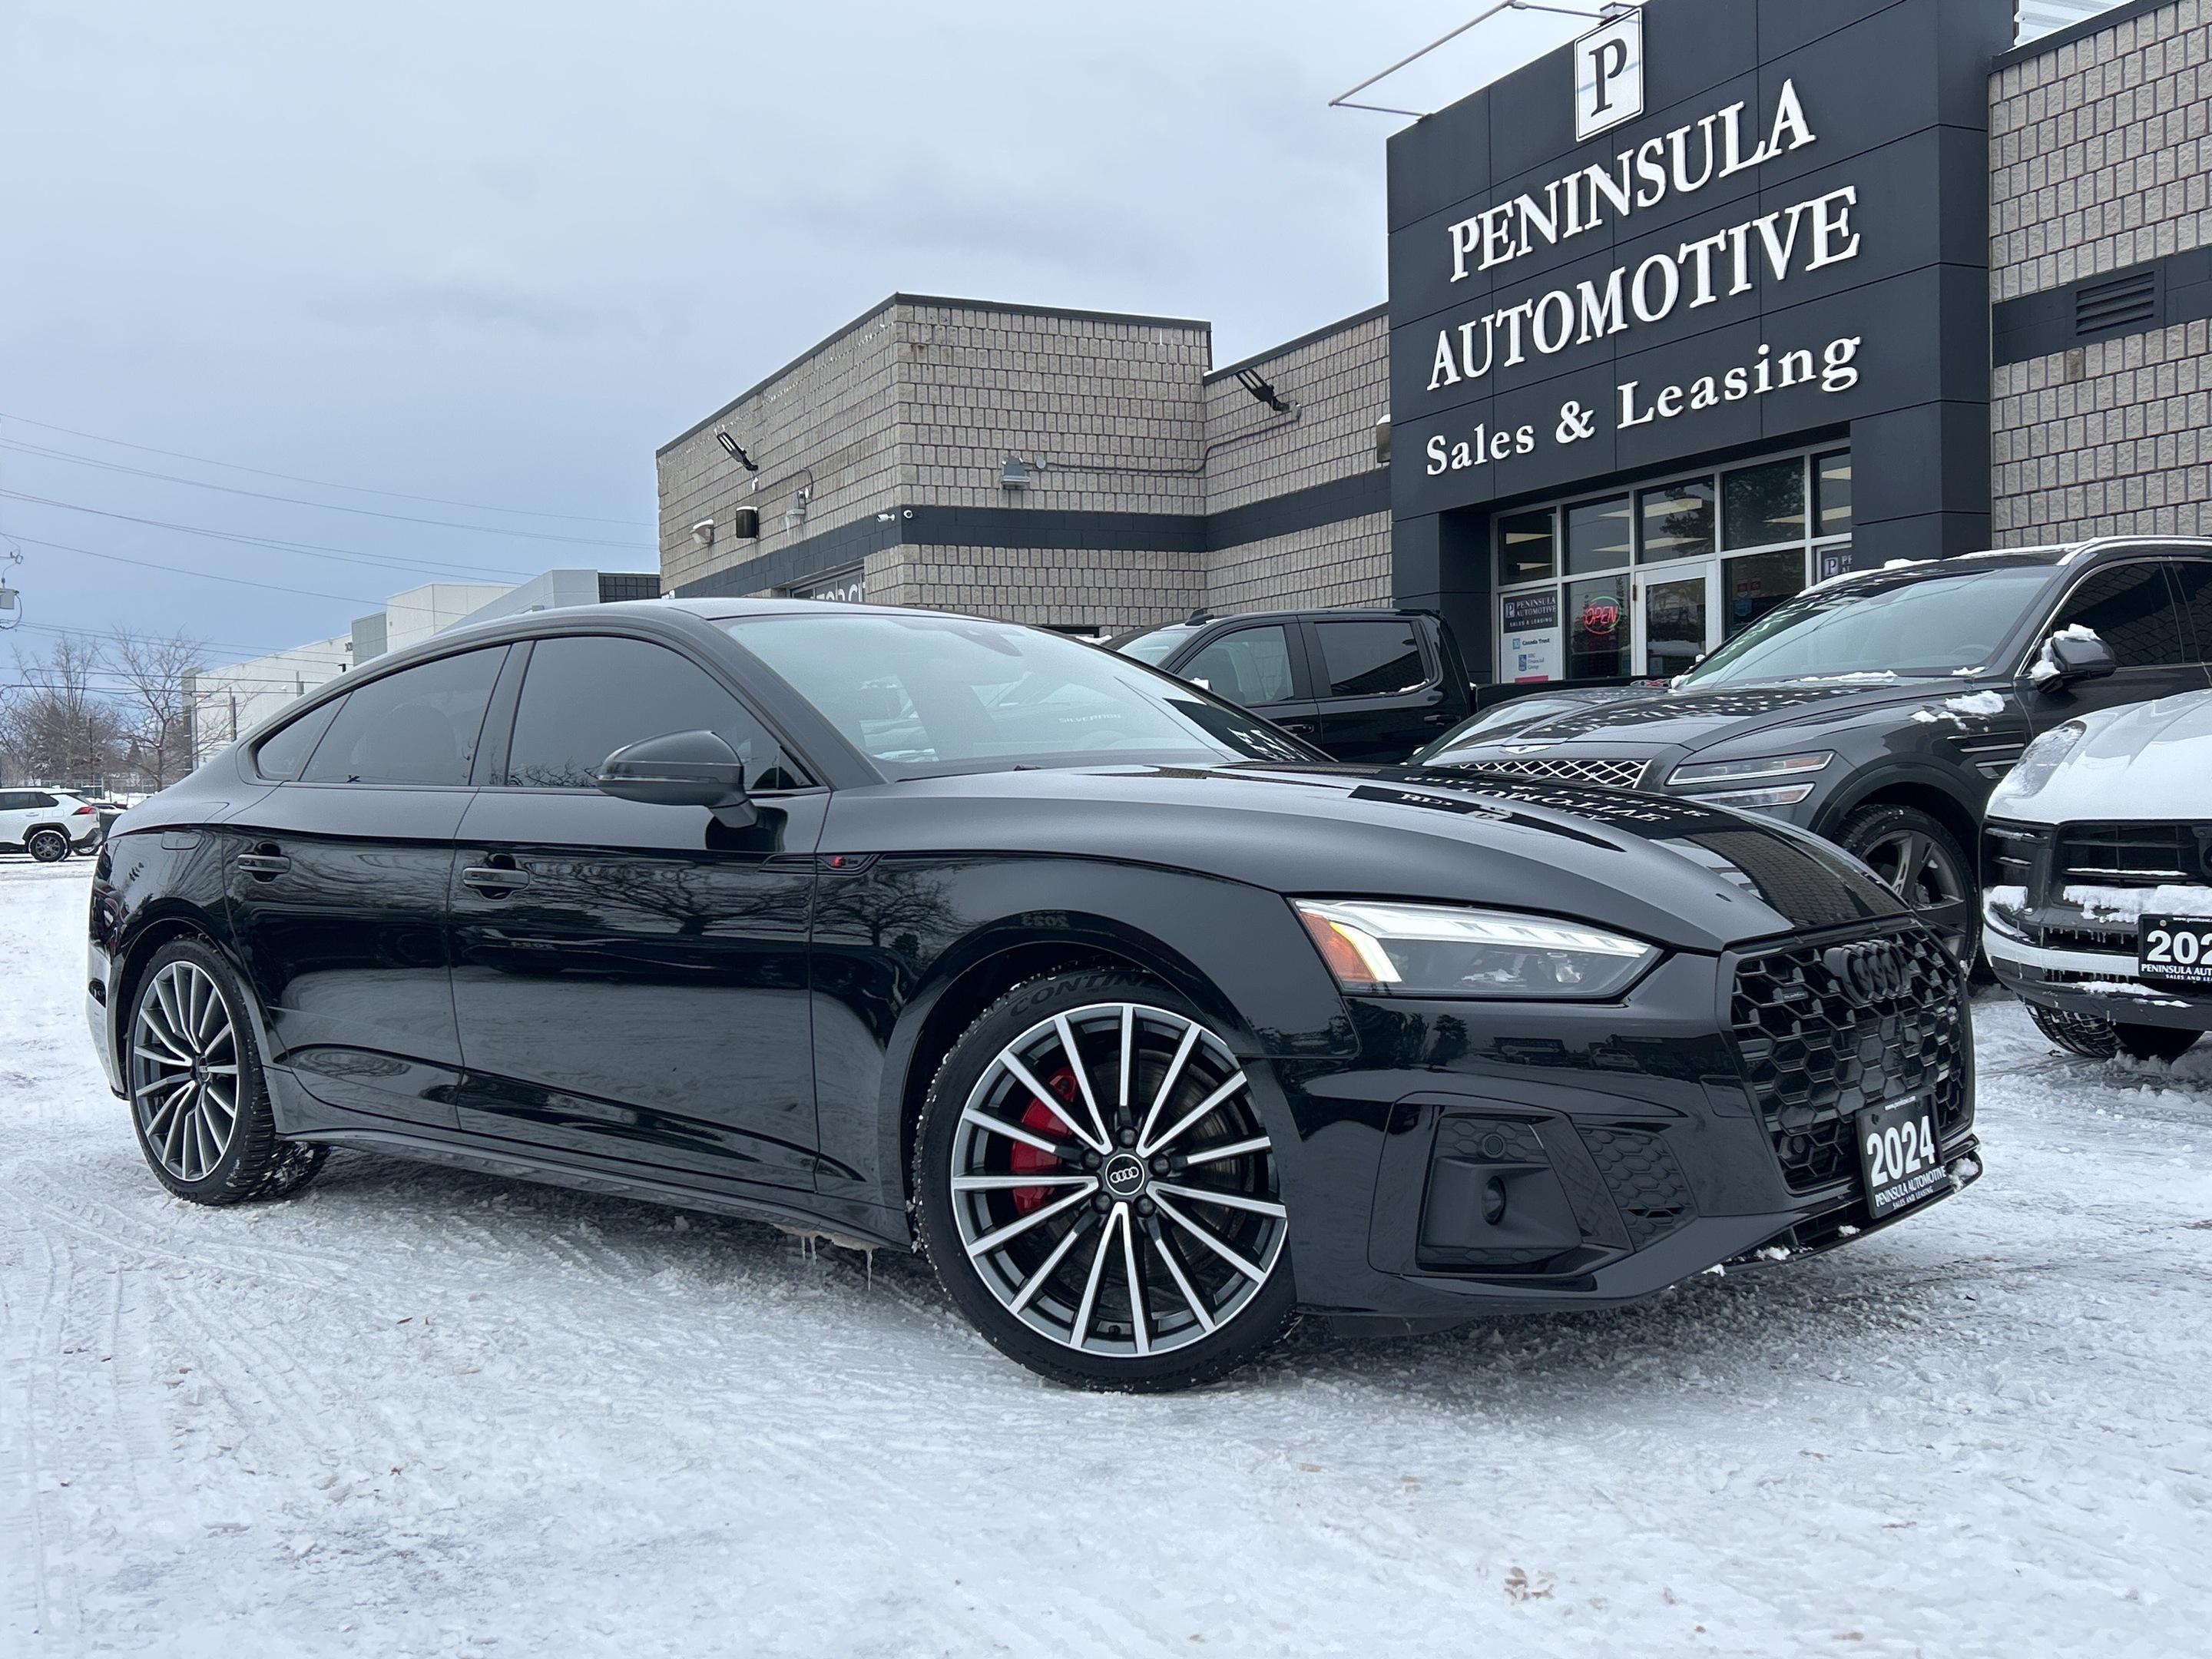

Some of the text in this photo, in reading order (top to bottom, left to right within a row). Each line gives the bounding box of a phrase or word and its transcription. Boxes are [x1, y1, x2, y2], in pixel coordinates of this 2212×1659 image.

[1588, 38, 1628, 118] P
[1449, 78, 1816, 283] PENINSULA
[1427, 186, 1860, 390] AUTOMOTIVE
[1426, 336, 1862, 475] Sales & Leasing
[1516, 597, 1556, 609] PENINSULA
[1516, 605, 1557, 617] AUTOMOTIVE
[1584, 605, 1618, 625] OPEN
[2141, 964, 2193, 975] PENINSULA
[1866, 1115, 1935, 1187] 2024
[1875, 1166, 1946, 1207] PENINSULA AUTOMOTIVE
